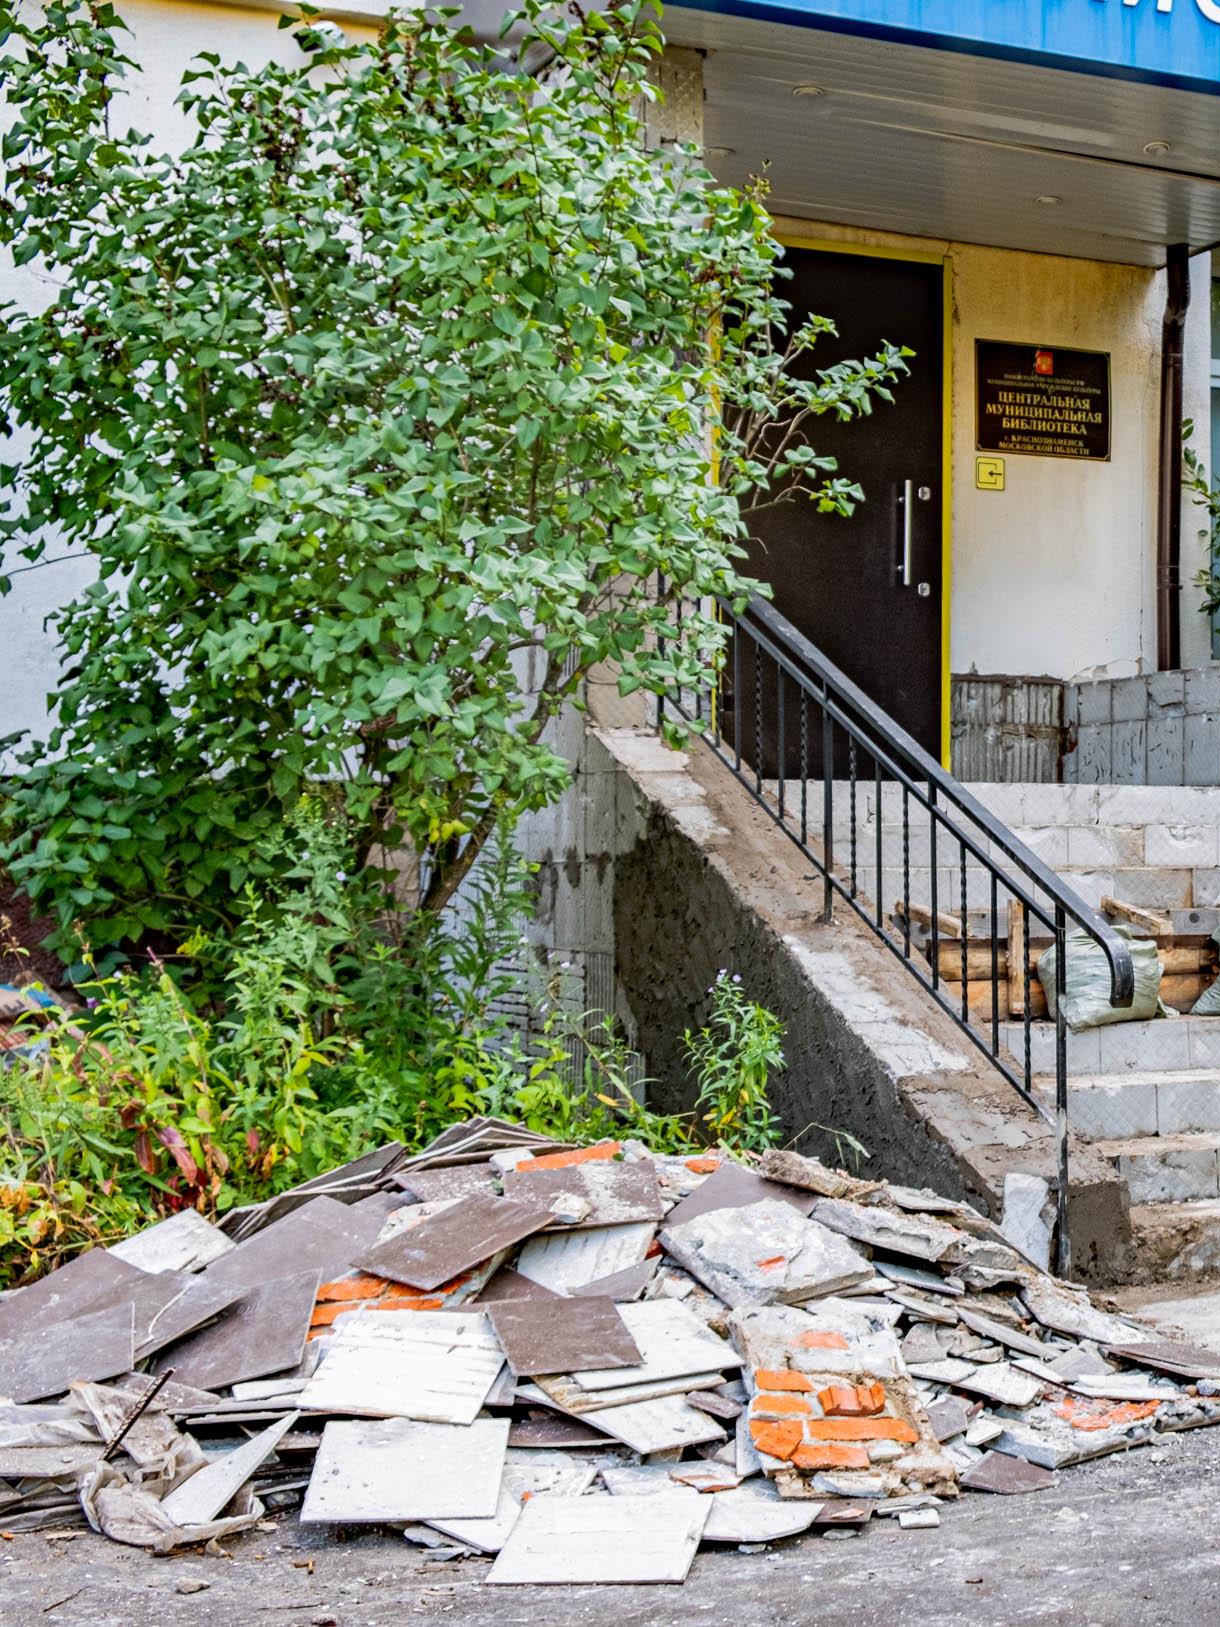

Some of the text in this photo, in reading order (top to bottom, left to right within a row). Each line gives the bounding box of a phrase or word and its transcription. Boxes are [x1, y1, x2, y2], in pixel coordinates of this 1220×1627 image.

[998, 391, 1090, 410] ЦЕНТРАЛЬНАЯ
[986, 403, 1102, 423] МУНИЦИПАЛЬНАЯ
[1002, 417, 1087, 436] БИБЛИОТЕКА
[998, 441, 1090, 455] МОСКОВСКОЙ ОБЛАСТИ
[1011, 434, 1084, 447] КРАСНОЗНАМЕНСК
